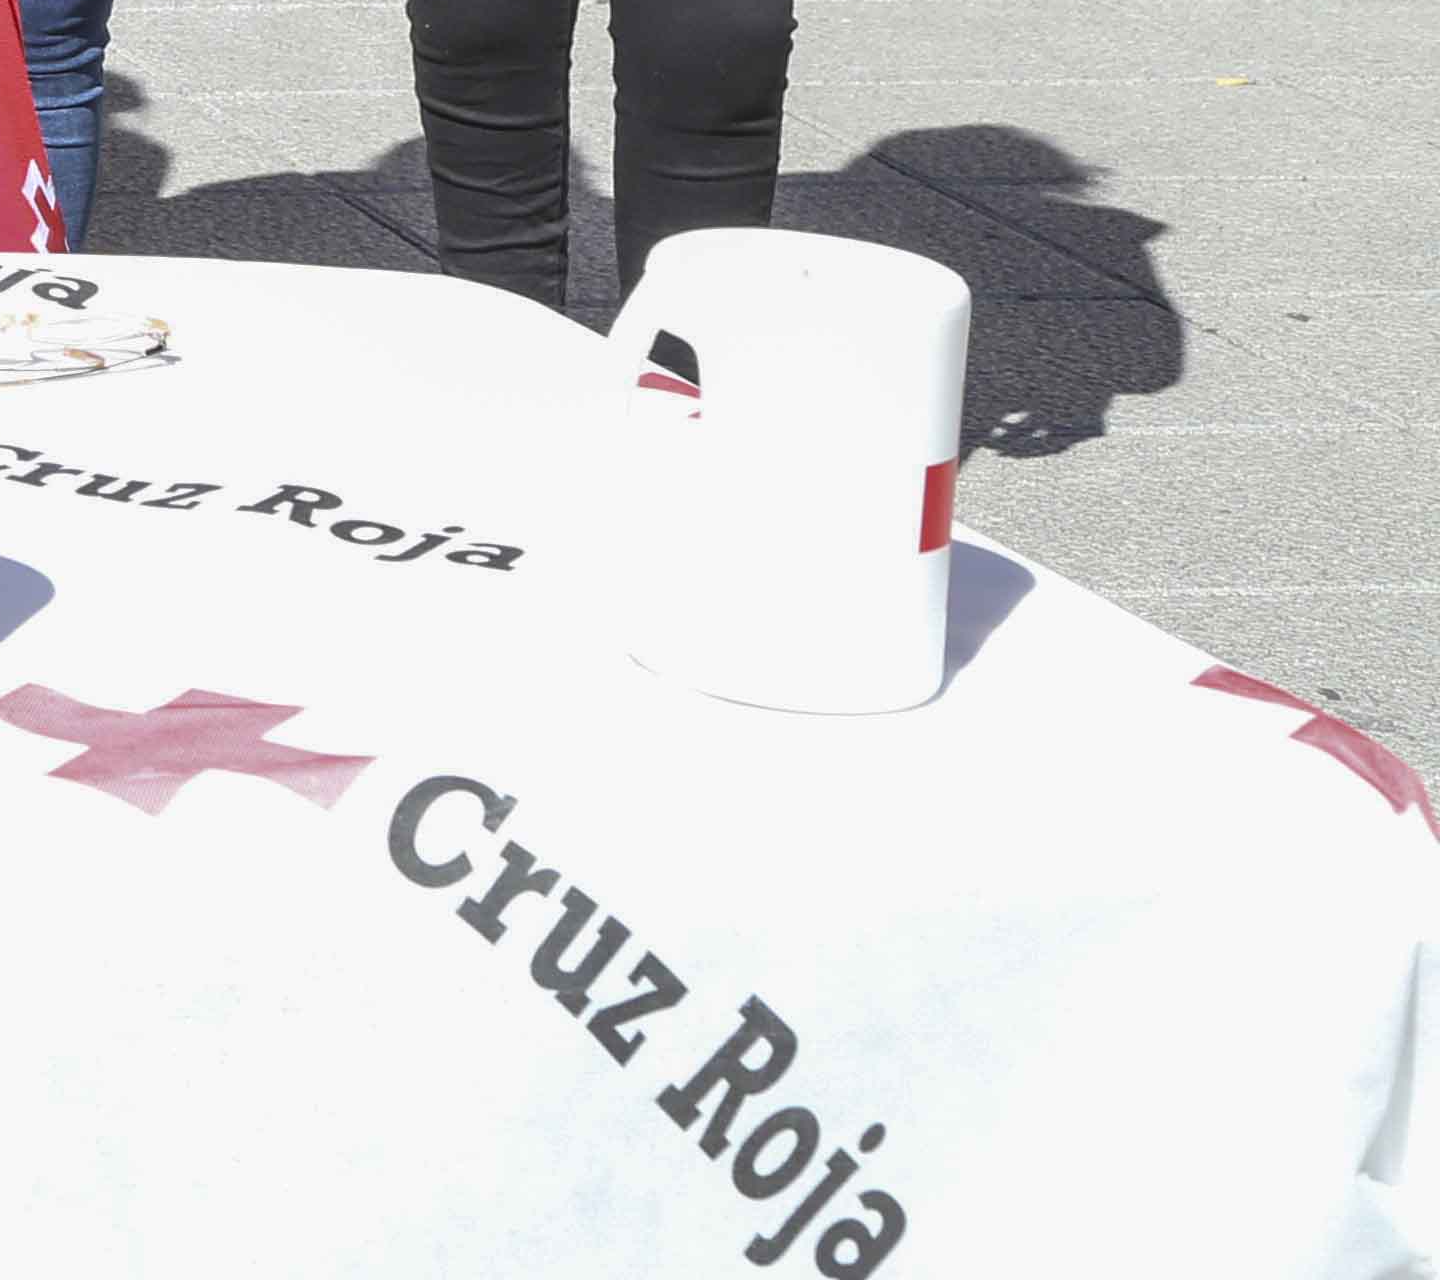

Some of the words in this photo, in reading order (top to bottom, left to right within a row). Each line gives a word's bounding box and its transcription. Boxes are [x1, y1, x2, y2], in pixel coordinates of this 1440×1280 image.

[234, 483, 528, 572] Roja
[386, 774, 689, 1068] Cruz
[654, 994, 909, 1280] Roja
